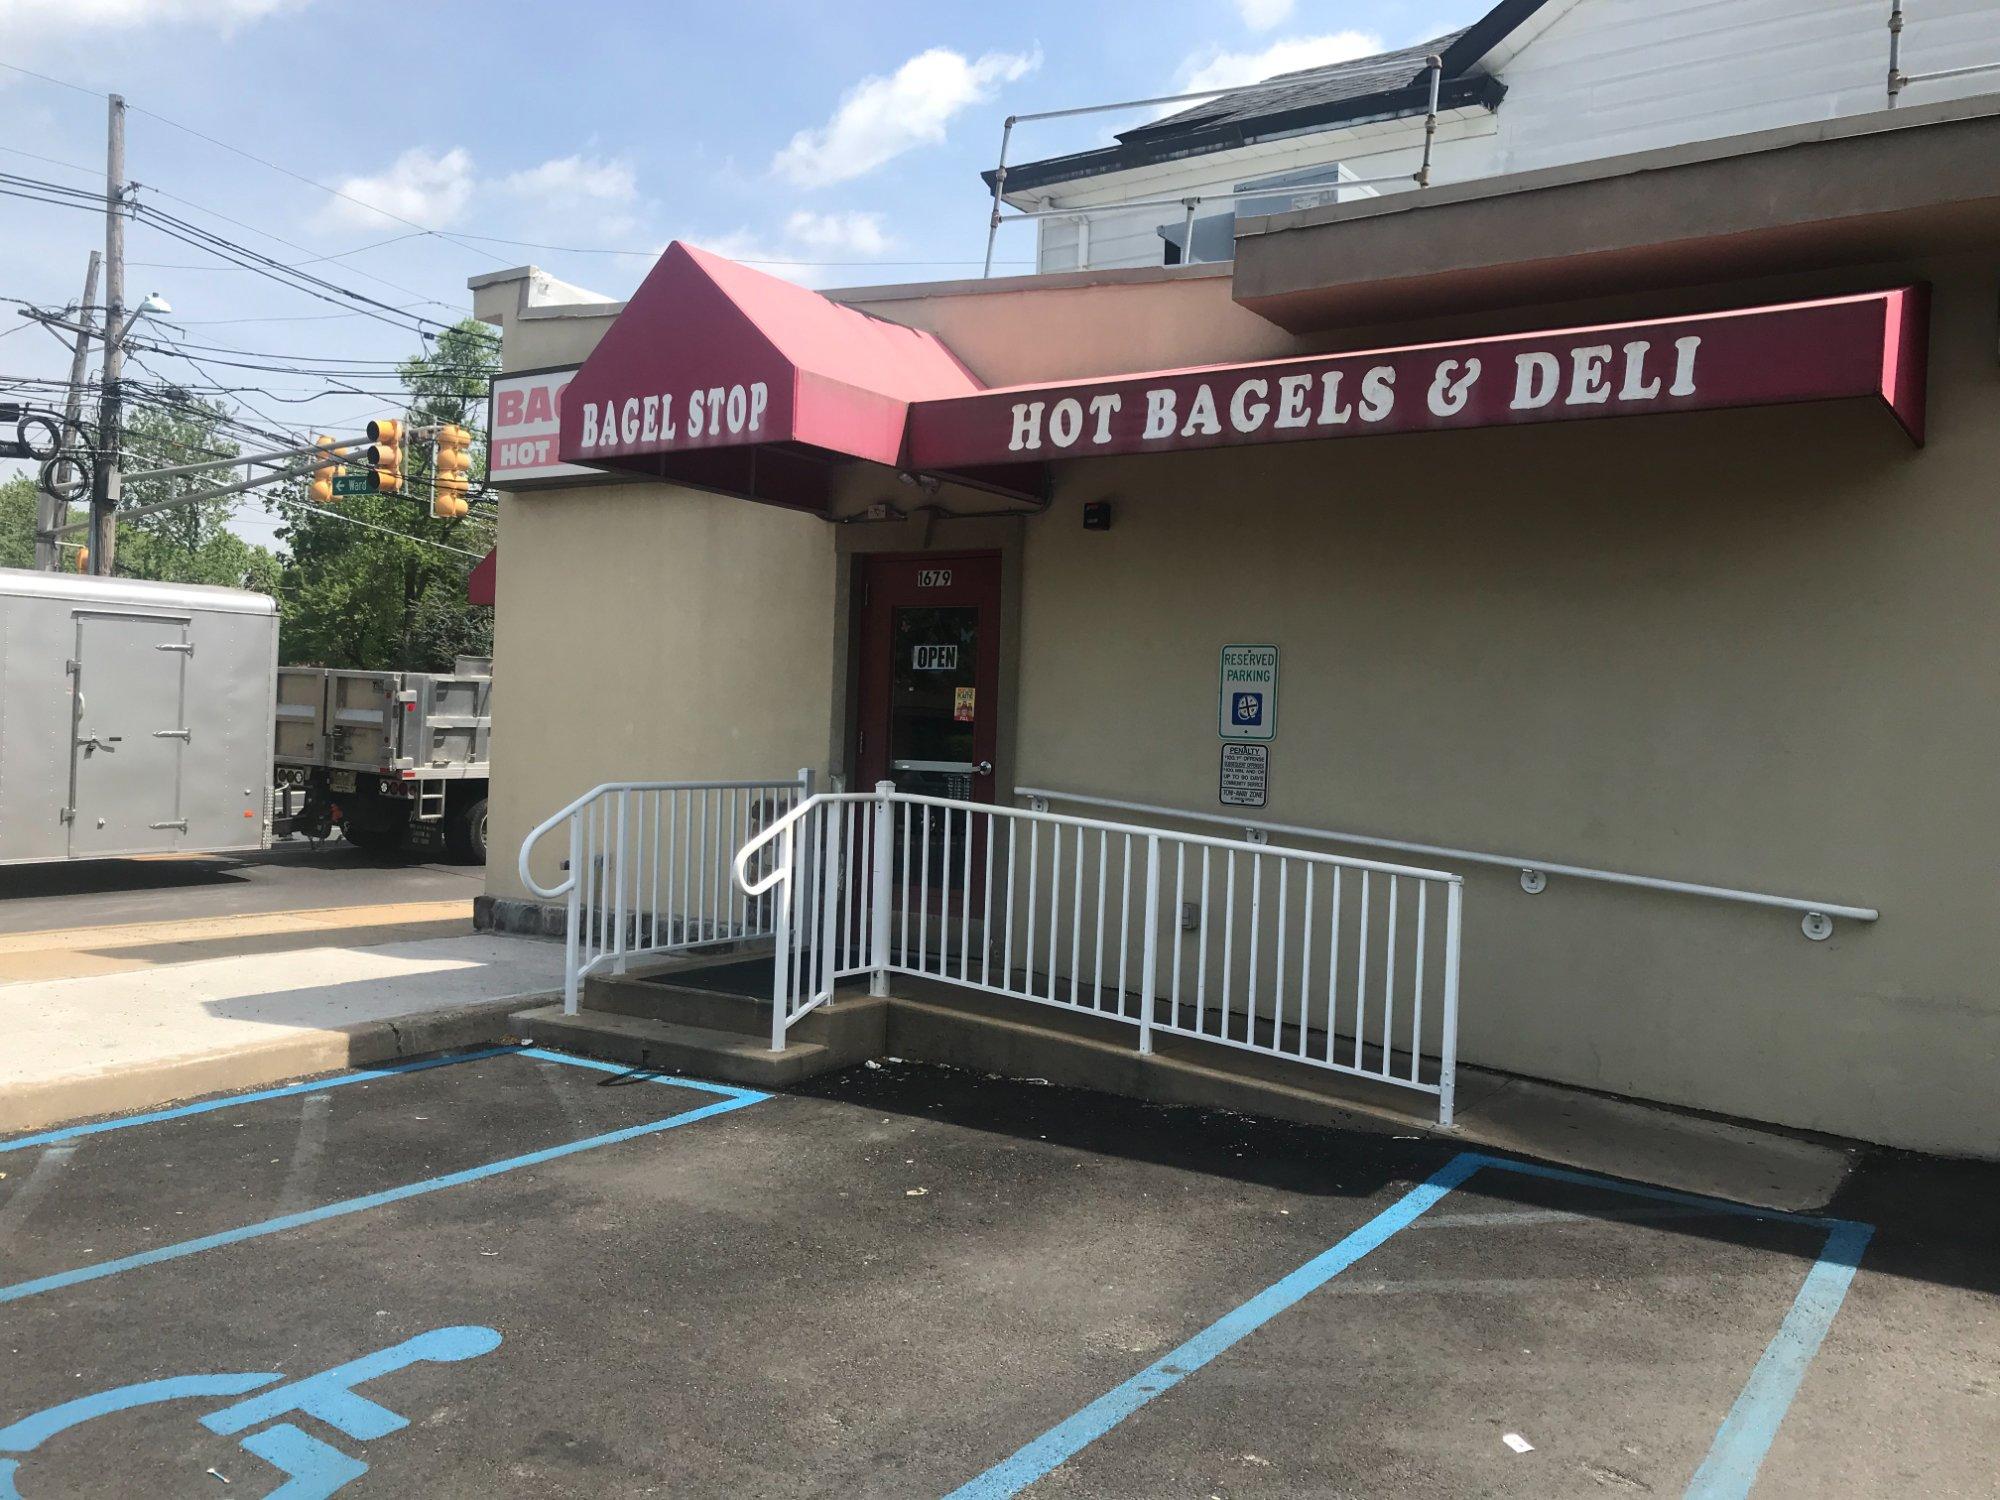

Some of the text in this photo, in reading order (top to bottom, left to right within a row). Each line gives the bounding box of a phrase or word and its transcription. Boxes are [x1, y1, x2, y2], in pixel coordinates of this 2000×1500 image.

[1008, 335, 1701, 450] HOT BAGELS & DELI
[581, 381, 768, 448] BAGEL STOP
[500, 440, 551, 467] HOT
[348, 480, 367, 491] Ward
[919, 571, 951, 586] 1679
[917, 646, 956, 668] OPEN
[1224, 653, 1275, 666] RESERVED
[1227, 669, 1271, 682] PARKING
[1229, 747, 1260, 755] PENALTY
